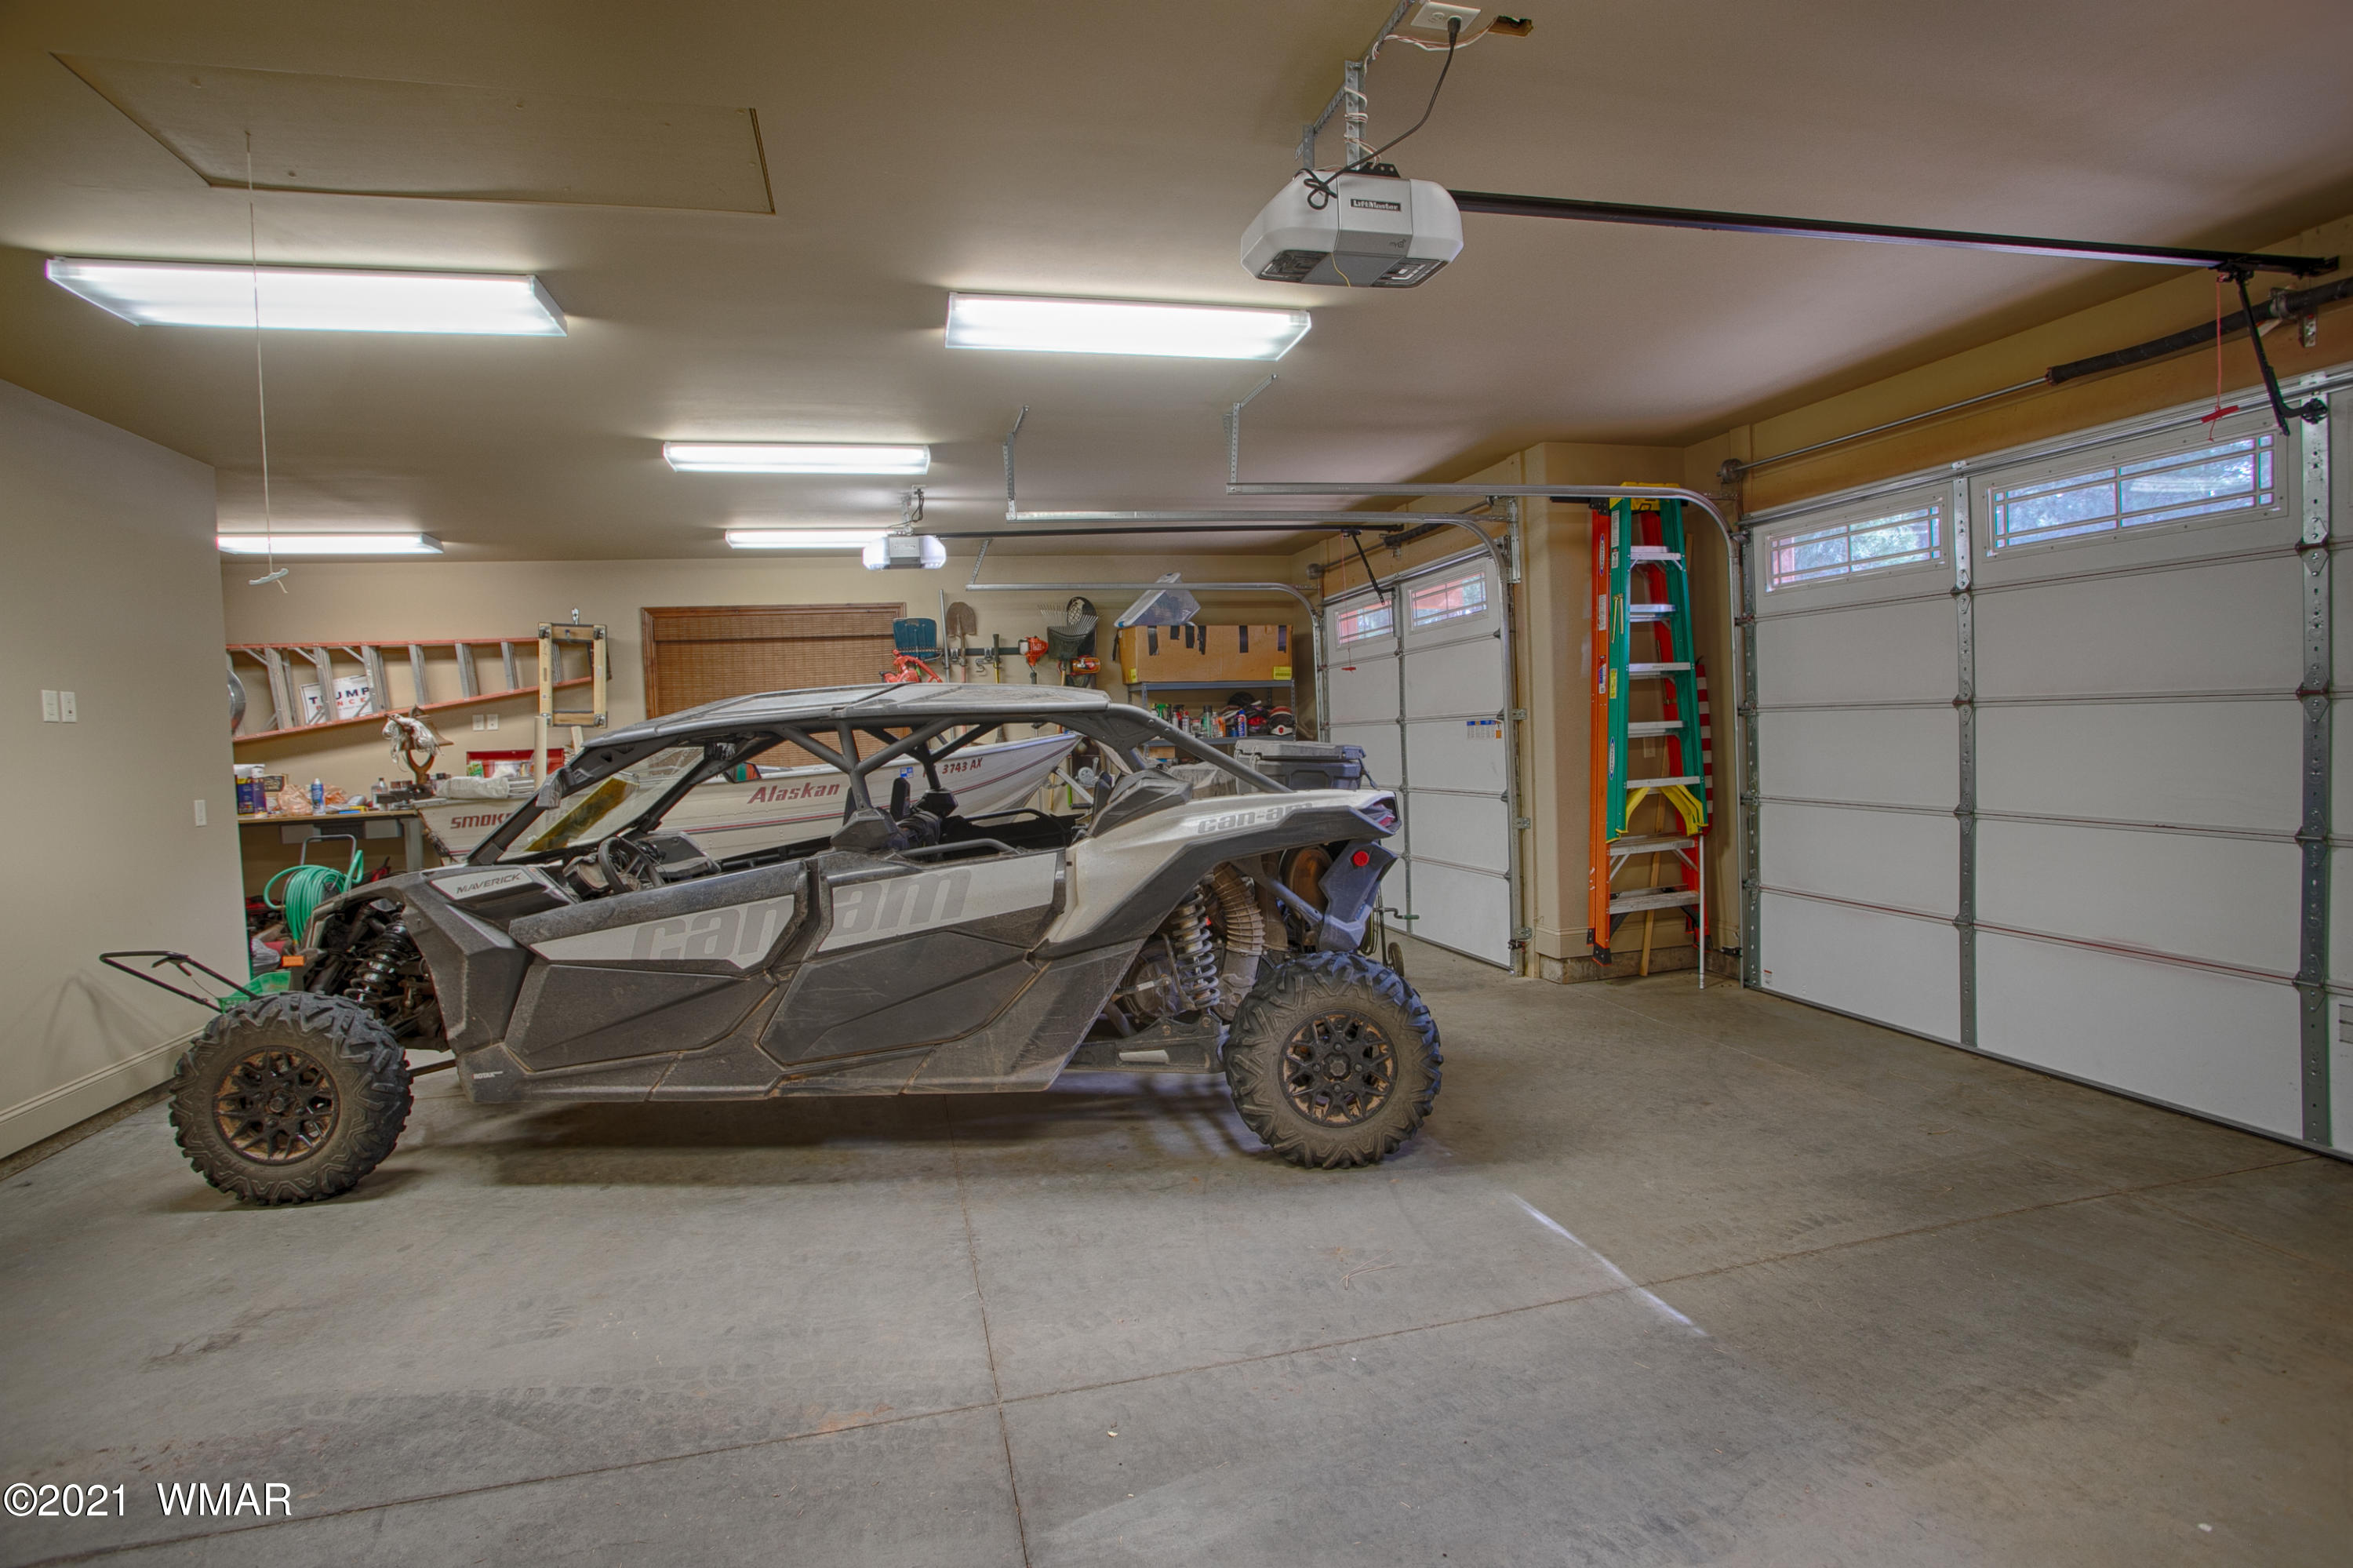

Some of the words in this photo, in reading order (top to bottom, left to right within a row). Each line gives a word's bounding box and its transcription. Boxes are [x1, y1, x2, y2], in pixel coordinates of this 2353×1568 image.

[1353, 200, 1398, 210] LiftMaster
[308, 687, 369, 704] TUMP
[315, 697, 365, 710] PNCE
[942, 762, 967, 774] 3743
[970, 758, 983, 770] AX
[747, 782, 840, 804] Alaskan
[456, 872, 522, 894] MAVERICK
